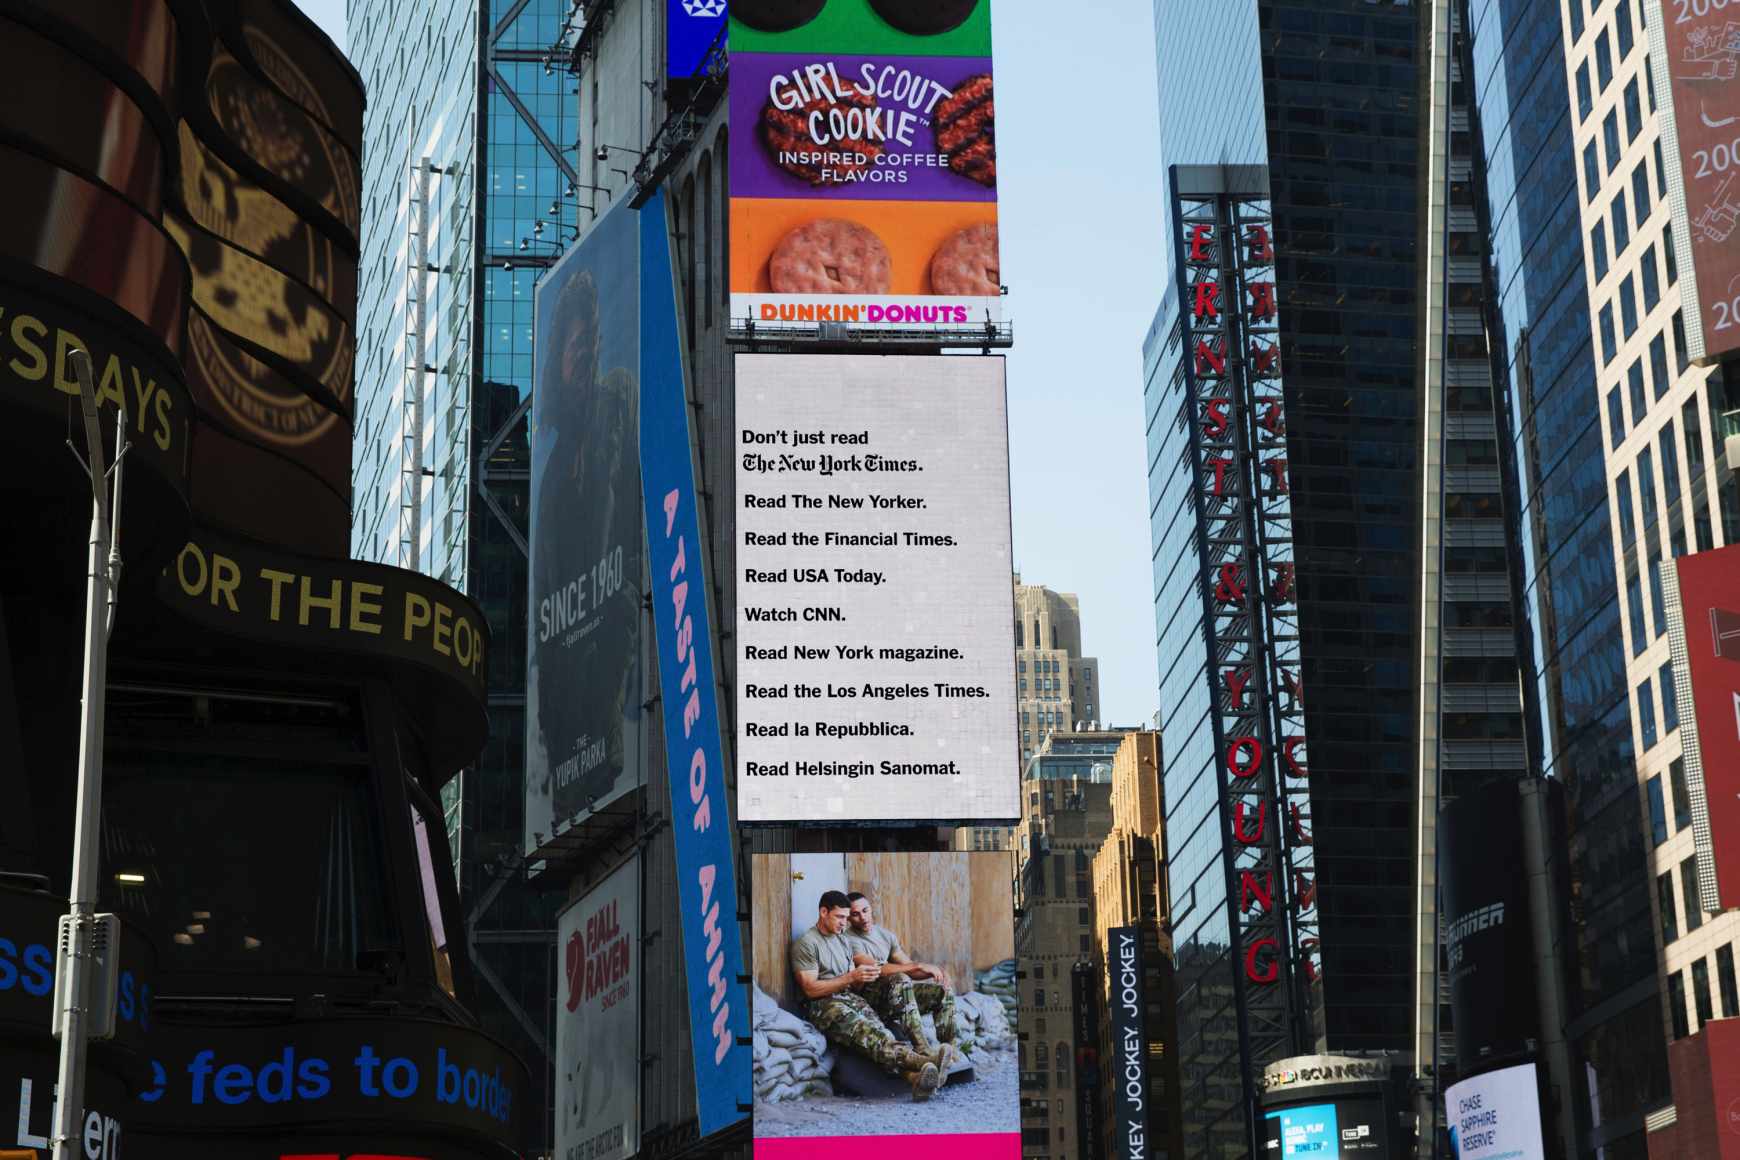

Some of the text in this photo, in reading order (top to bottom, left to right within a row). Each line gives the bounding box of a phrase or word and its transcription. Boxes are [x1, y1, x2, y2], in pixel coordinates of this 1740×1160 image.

[770, 62, 953, 114] GIRL SCOUT
[779, 152, 949, 166] INSPIRED COFFEE
[821, 170, 908, 182] FLAVORS
[0, 307, 172, 450] SDAYS
[742, 430, 868, 447] Don't just read
[743, 454, 923, 476] The New York Times.
[745, 494, 927, 508] Read The New Yorker.
[664, 489, 679, 539] A
[745, 532, 957, 546] Read the Financial Times.
[162, 542, 240, 613] OR
[260, 568, 384, 634] THE
[745, 569, 886, 585] Read USA Today.
[540, 545, 623, 643] SINCE 1960
[1191, 224, 1226, 496] ERNST
[1224, 670, 1278, 983] YOUNG
[745, 607, 846, 621] Watch CNN.
[671, 535, 700, 740] TASTE
[745, 645, 964, 662] Read New York magazine.
[745, 684, 990, 700] Read the Los Angeles Times.
[746, 722, 914, 739] Read la Repubblica.
[746, 760, 961, 778] Read Helsingin Sanomat.
[690, 747, 711, 833] OF
[1119, 934, 1138, 1018] JOCKEY
[187, 1047, 331, 1105] feds
[354, 1045, 419, 1099] to
[1123, 1027, 1143, 1111] JOCKEY
[1459, 1094, 1482, 1114] CHASE
[1461, 1110, 1497, 1133] SAPPHIRE
